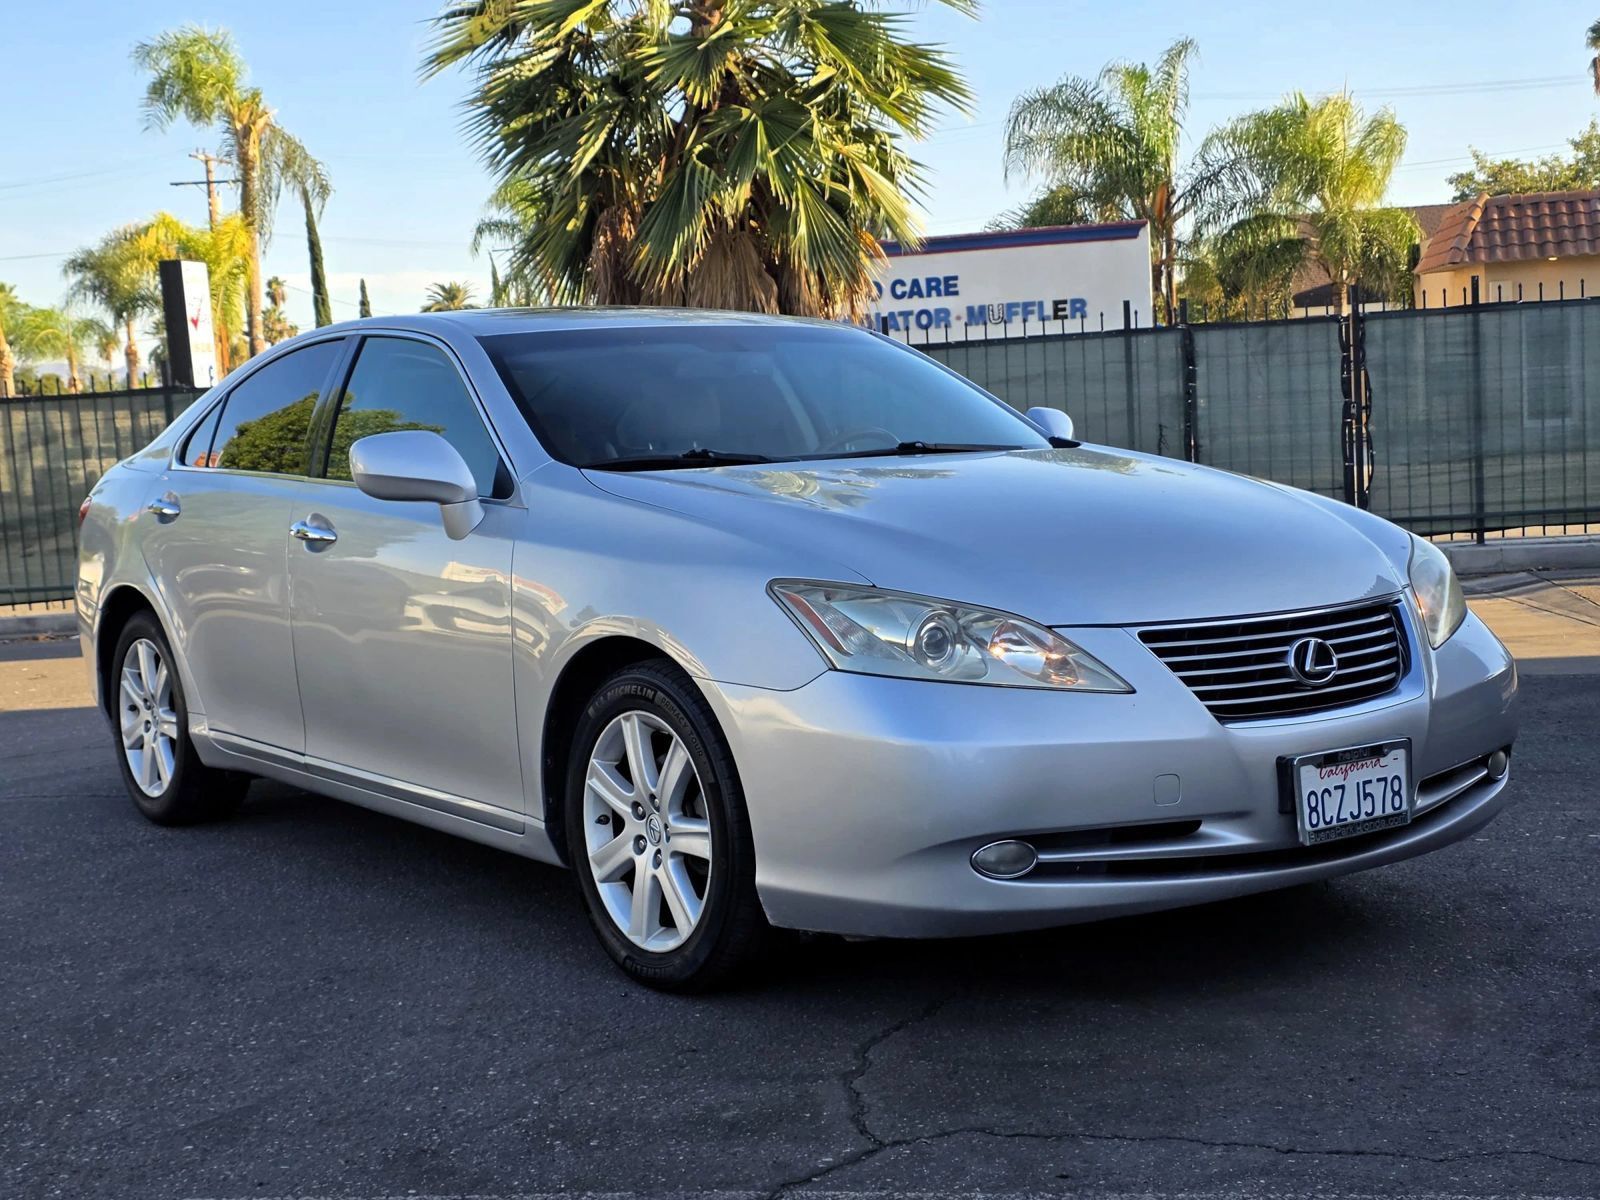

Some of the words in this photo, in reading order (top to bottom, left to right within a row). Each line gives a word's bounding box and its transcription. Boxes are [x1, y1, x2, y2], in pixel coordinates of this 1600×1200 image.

[890, 275, 960, 300] CARE
[866, 307, 952, 333] IATOR
[966, 298, 1087, 326] MUFFLER
[607, 684, 656, 701] MICHELIN
[661, 697, 689, 729] PRIMACY
[688, 731, 704, 758] TOUR
[1319, 757, 1389, 781] California
[1307, 774, 1403, 829] 8CZJ578
